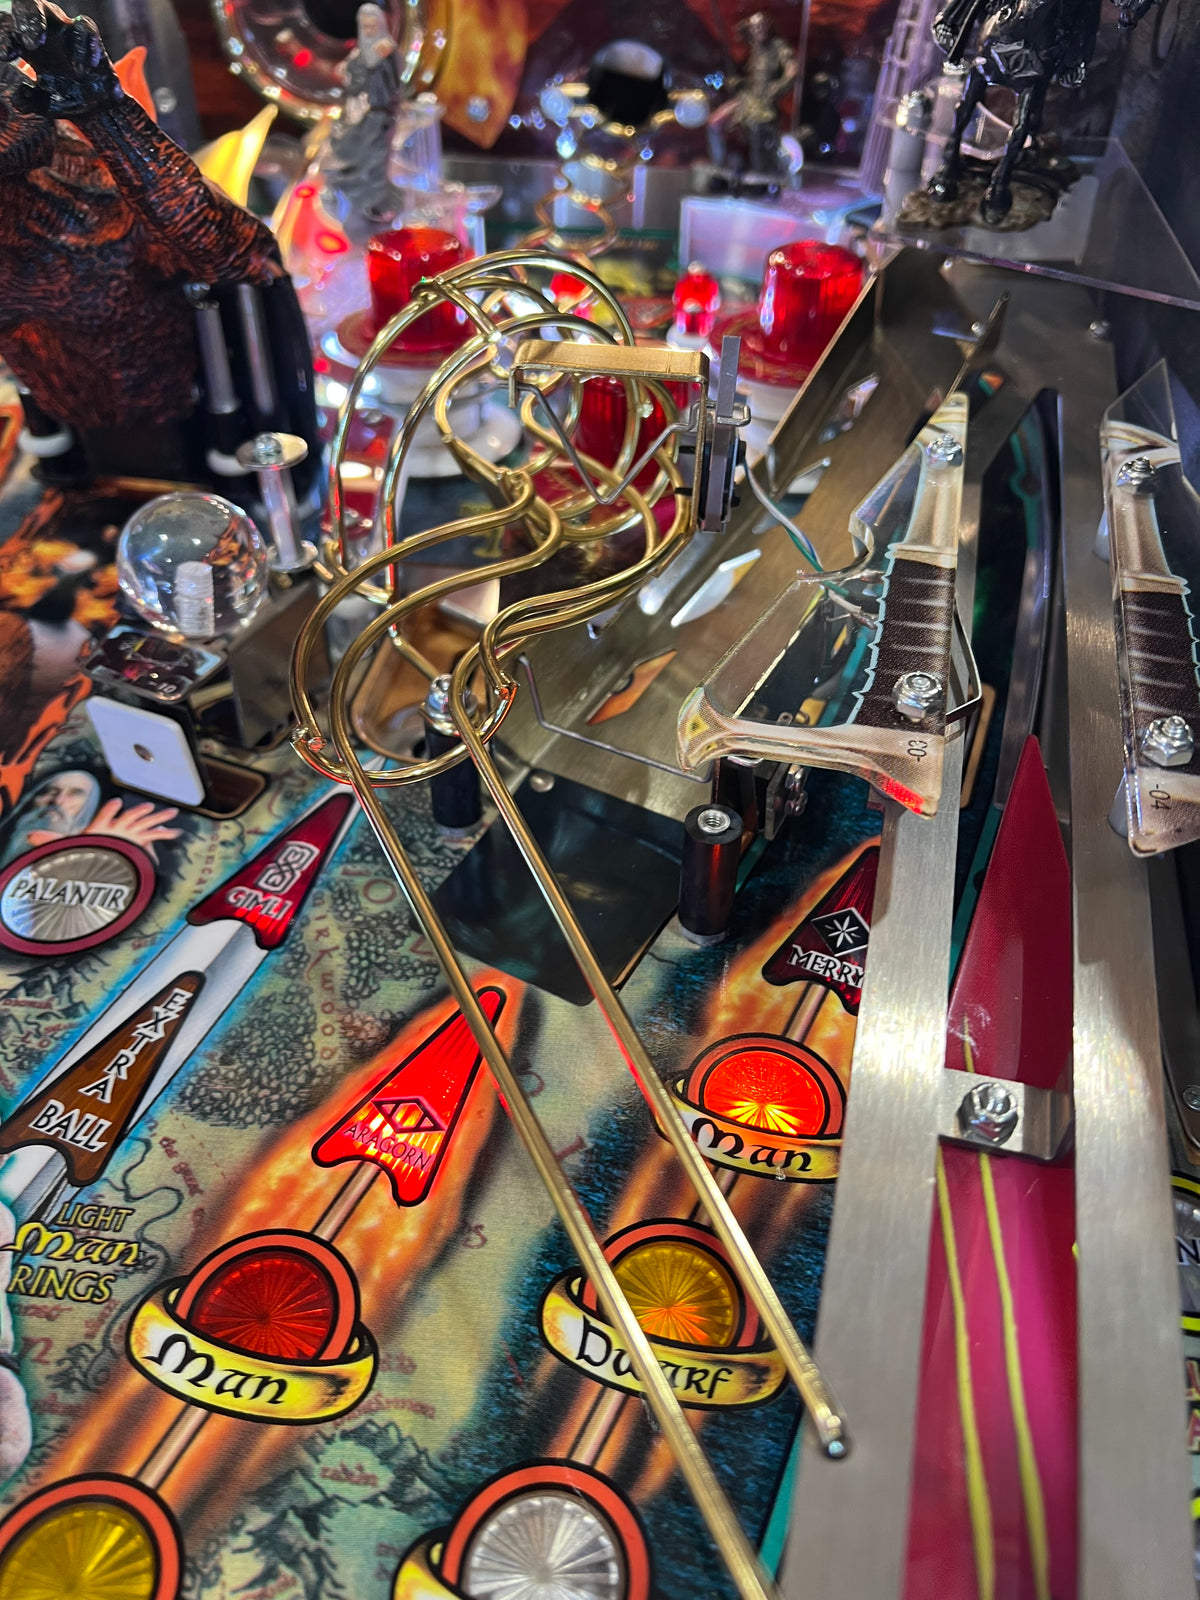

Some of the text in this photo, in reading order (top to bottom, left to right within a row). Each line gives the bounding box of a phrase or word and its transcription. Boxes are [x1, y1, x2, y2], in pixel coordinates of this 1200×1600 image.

[10, 877, 129, 911] PALANTIR
[227, 885, 293, 920] GIMLI
[788, 943, 865, 989] MERRY
[78, 988, 193, 1103] EXTRA
[28, 1099, 112, 1152] BALL
[343, 1123, 432, 1171] ARAGORN
[691, 1117, 812, 1172] Man
[55, 1201, 136, 1232] LIGHT
[0, 1221, 140, 1266] Man
[6, 1264, 117, 1304] RINGS
[141, 1333, 288, 1404] Man
